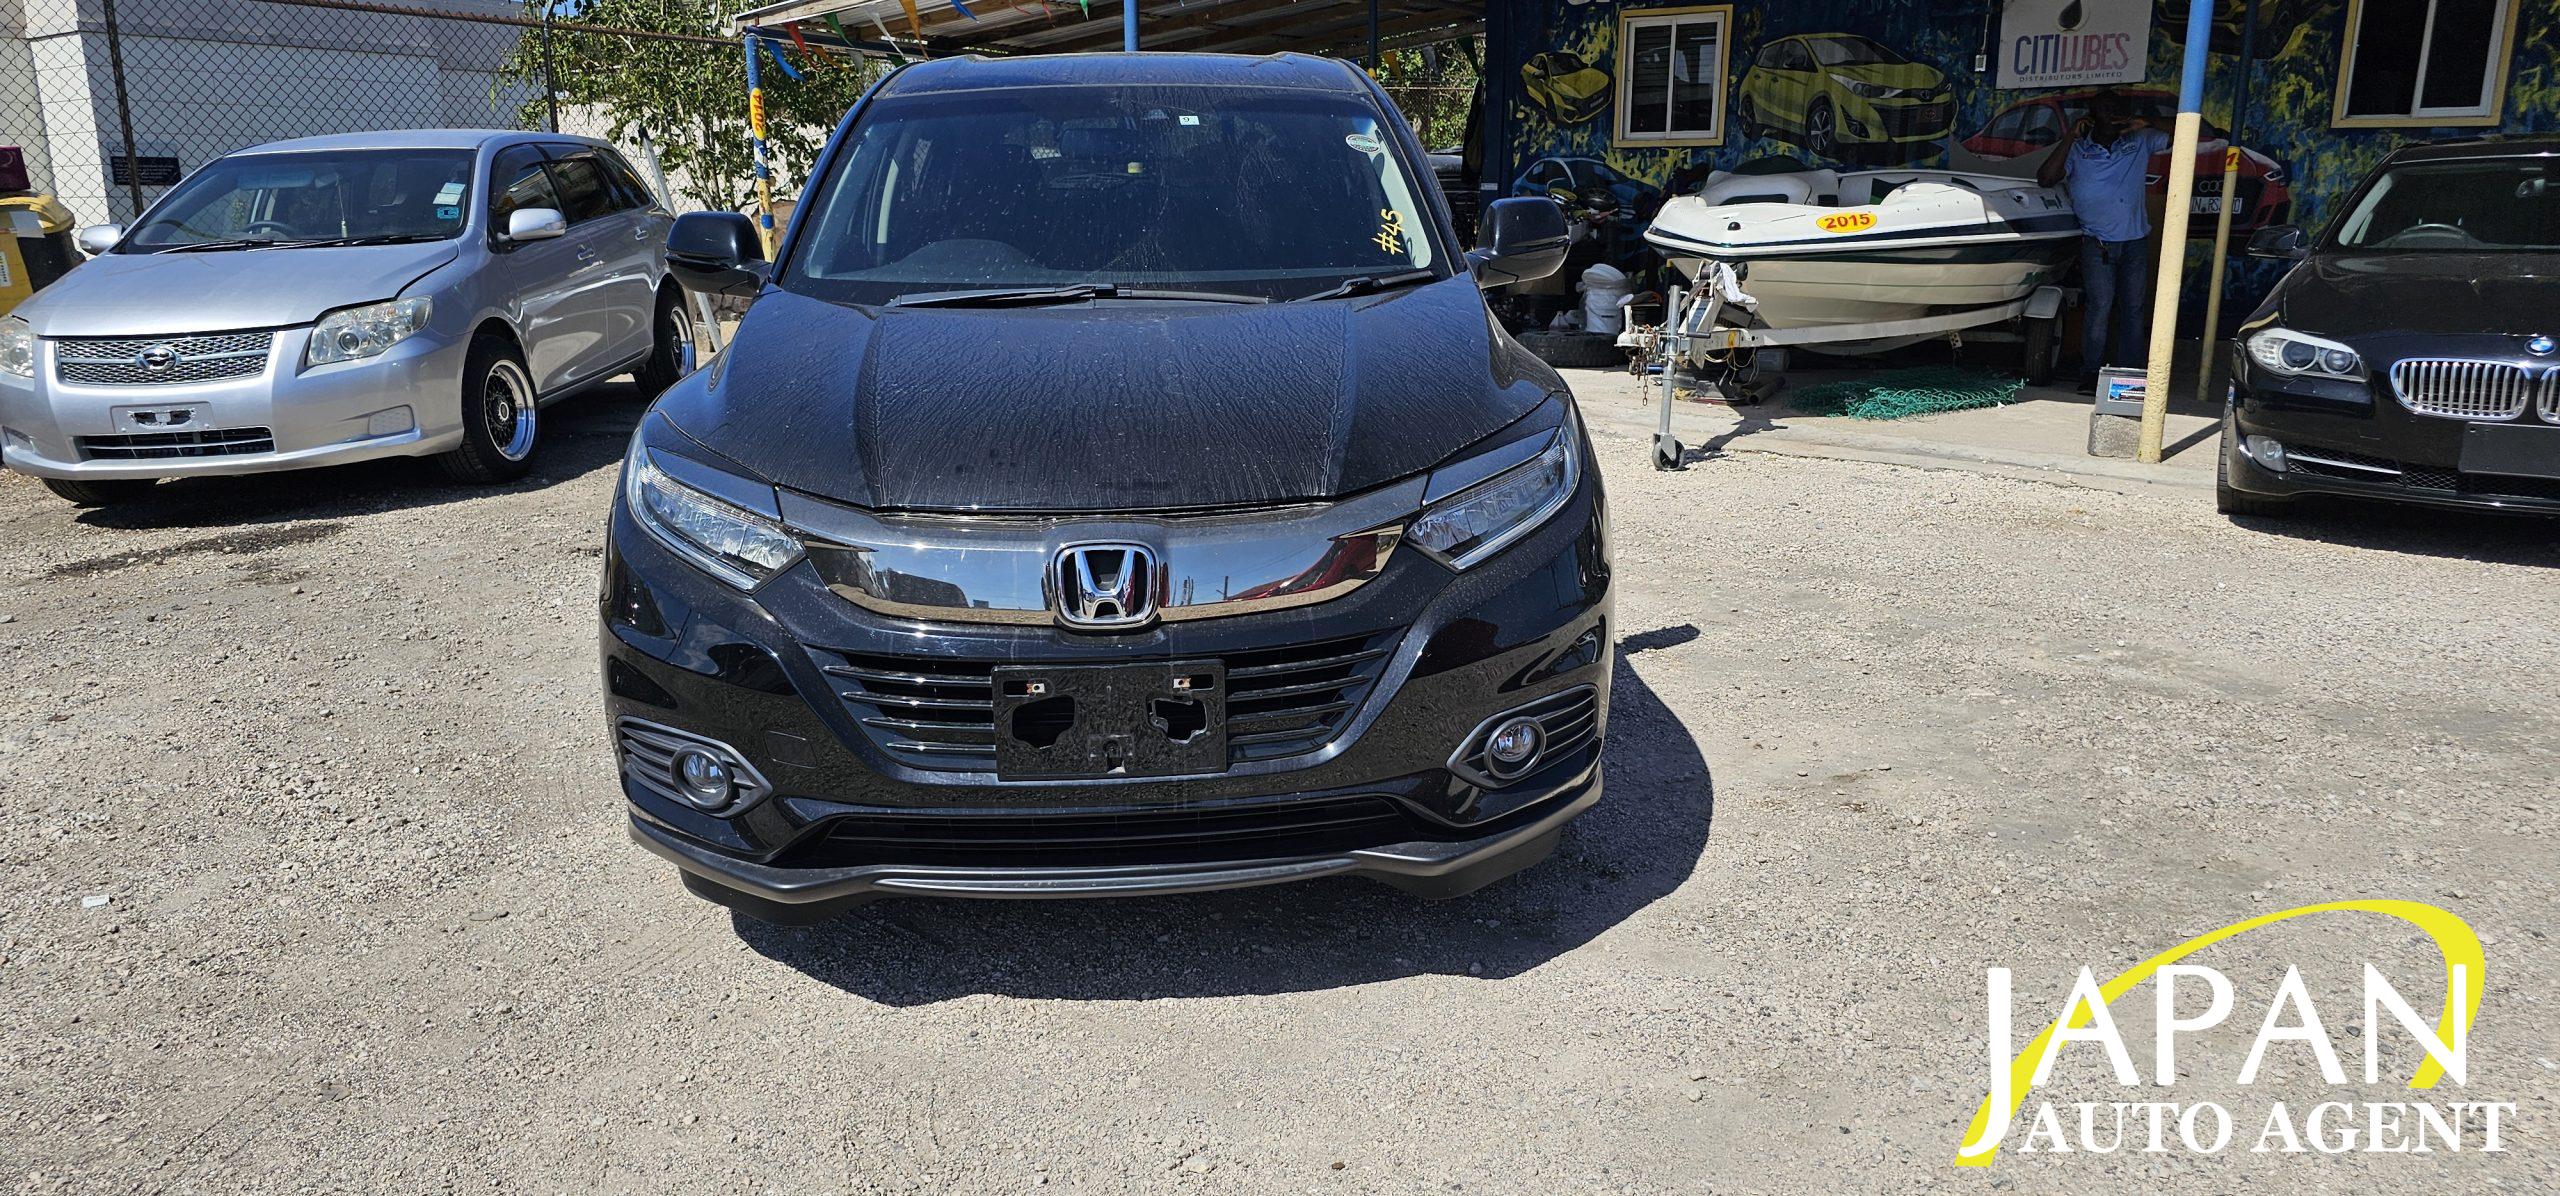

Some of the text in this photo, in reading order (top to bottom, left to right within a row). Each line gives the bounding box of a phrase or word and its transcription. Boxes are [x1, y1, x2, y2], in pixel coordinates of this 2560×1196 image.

[2013, 33, 2131, 76] CITILUBES
[2019, 74, 2082, 82] DISTRIBUTORS
[753, 94, 764, 132] 2014
[1371, 208, 1405, 255] #45
[1825, 213, 1870, 229] 2015
